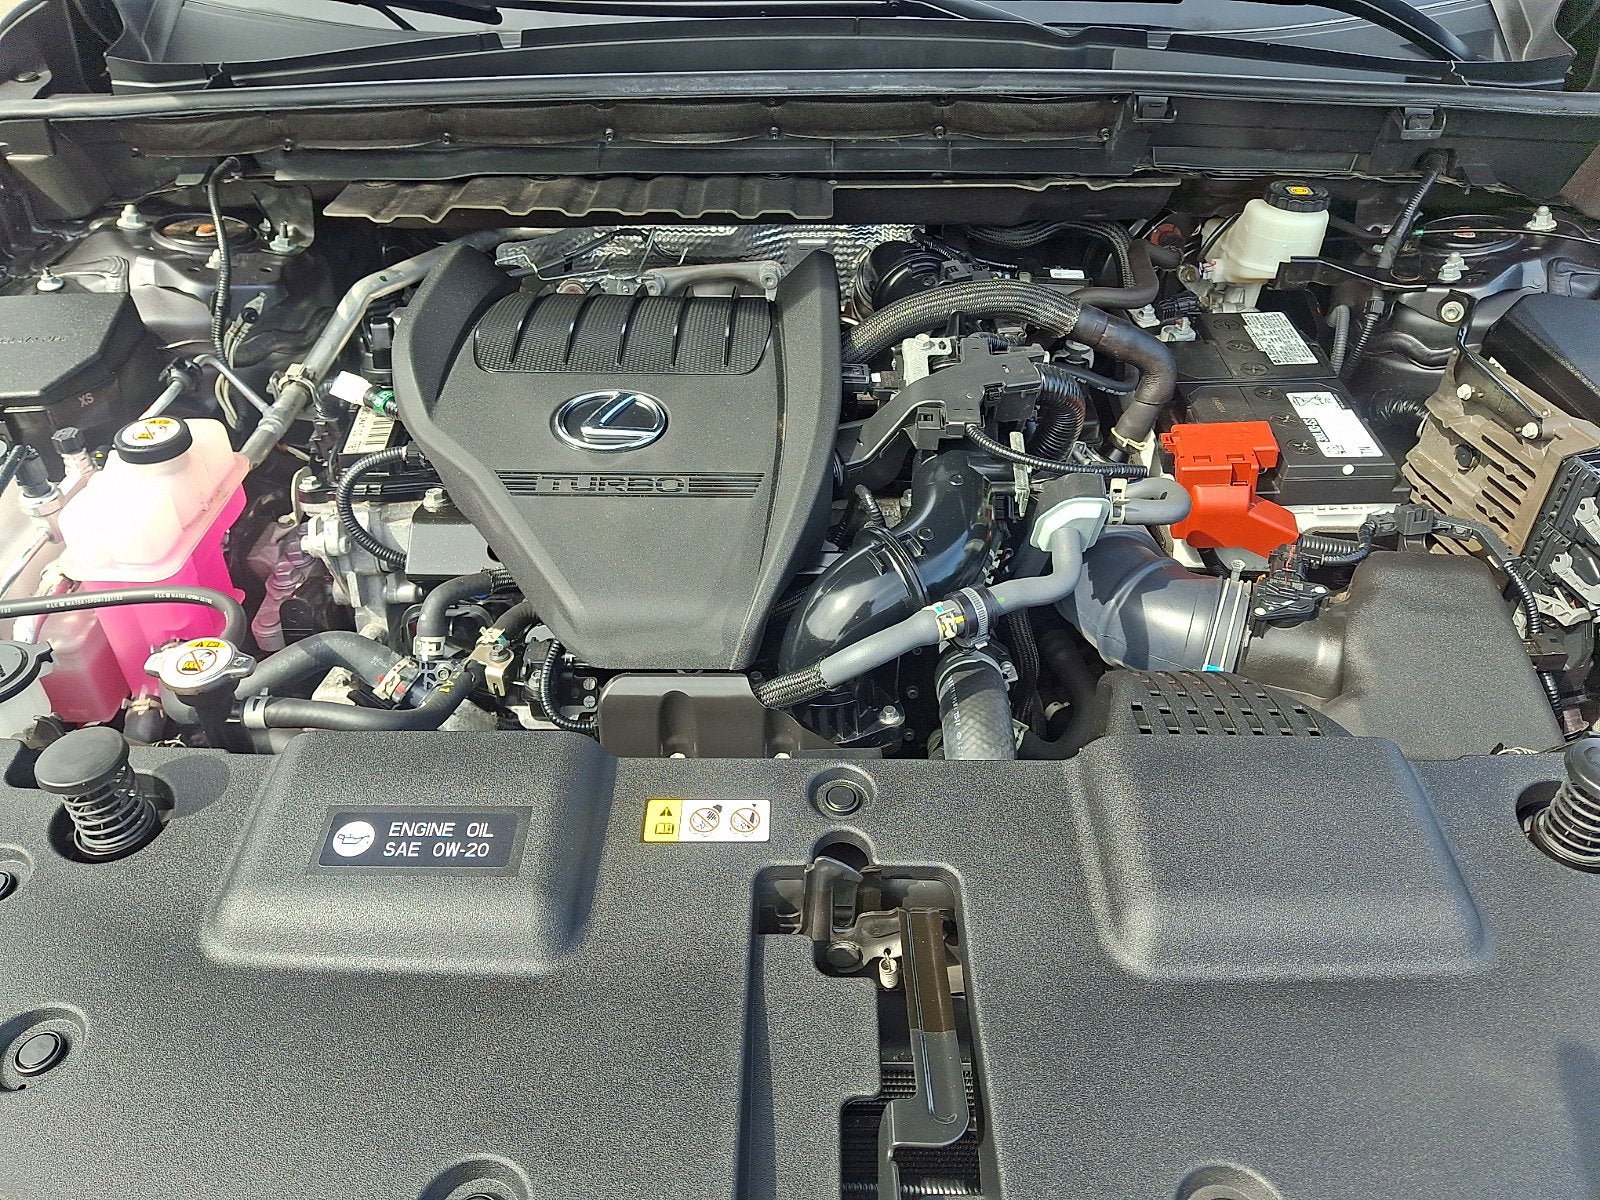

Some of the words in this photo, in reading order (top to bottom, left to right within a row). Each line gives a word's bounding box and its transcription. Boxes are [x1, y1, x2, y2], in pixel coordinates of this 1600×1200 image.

[540, 476, 686, 493] TURBO
[388, 821, 456, 837] ENGINE
[466, 822, 494, 838] OIL
[383, 841, 422, 857] SAE
[432, 842, 490, 858] 0W-20
